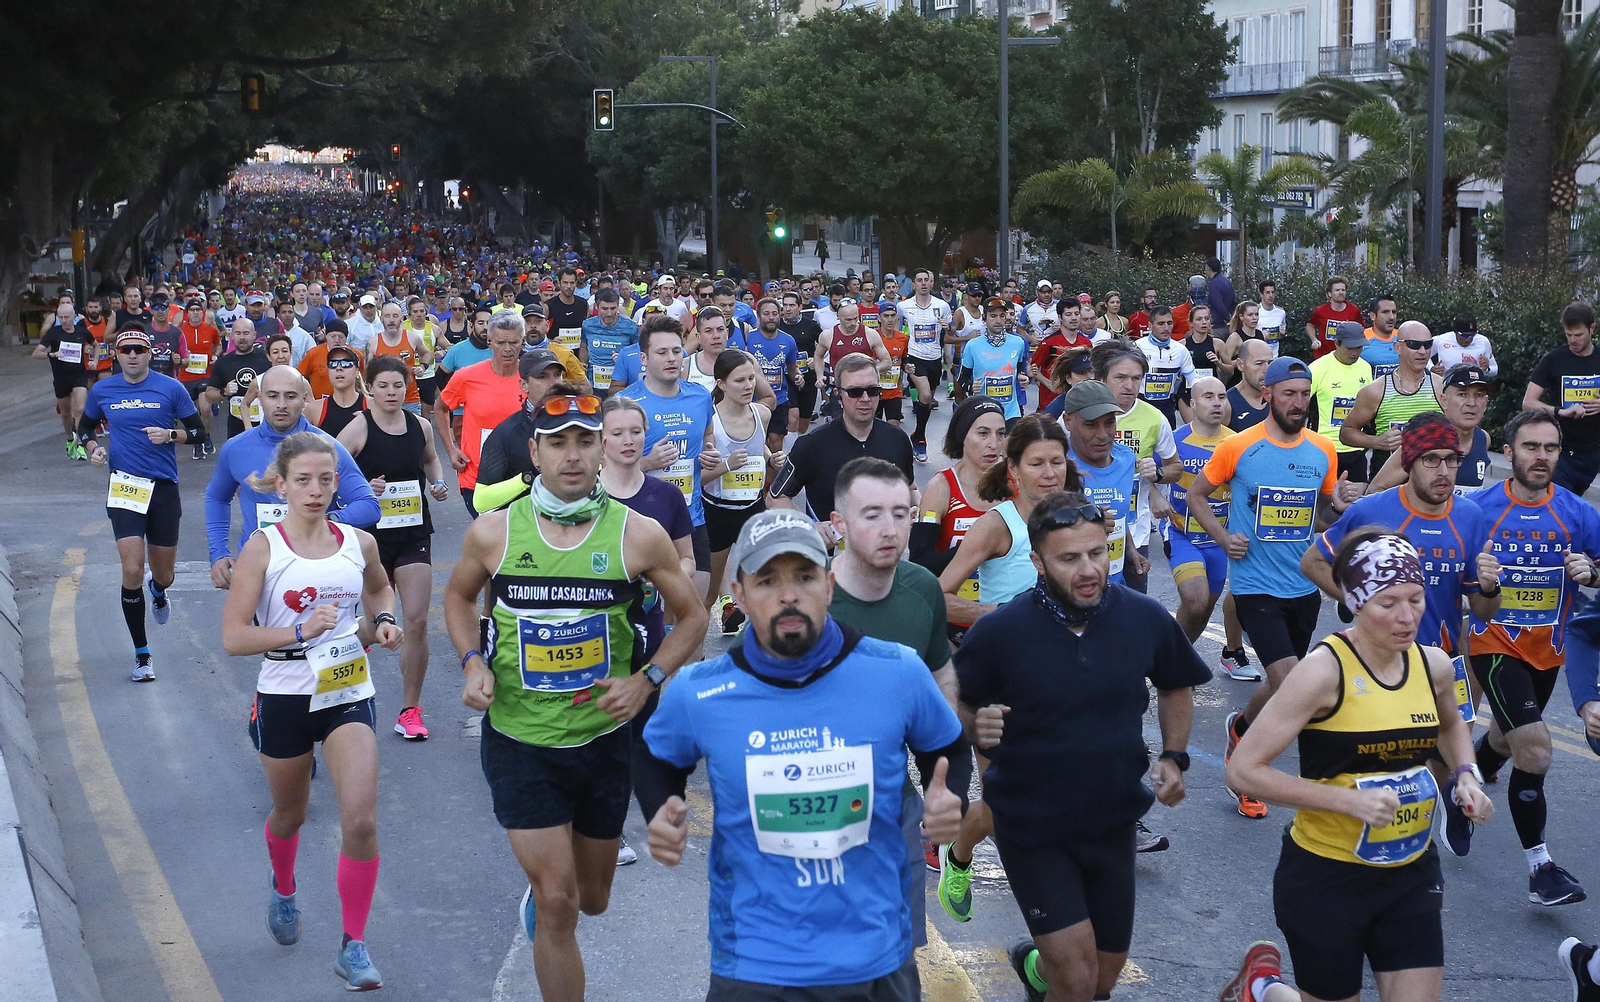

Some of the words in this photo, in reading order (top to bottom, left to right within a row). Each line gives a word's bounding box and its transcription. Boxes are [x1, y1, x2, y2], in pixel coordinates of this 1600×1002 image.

[120, 485, 138, 494] 5591
[391, 499, 411, 509] 5434
[1276, 509, 1299, 519] 1027
[1502, 530, 1557, 540] CLUB
[1417, 547, 1456, 559] LUB
[320, 586, 342, 596] Stiftung
[508, 585, 549, 600] STADIUM
[551, 586, 614, 601] CASABLANCA
[1515, 591, 1543, 601] 1238
[554, 625, 588, 637] ZURICH
[340, 642, 358, 653] ZURICH
[547, 646, 584, 662] 1453
[333, 663, 355, 681] 5557
[697, 684, 725, 699] luanvi
[1411, 713, 1438, 723] EMMA
[770, 728, 818, 742] ZURICH
[771, 739, 819, 753] MARATÓN
[1358, 741, 1397, 754] NIDD
[807, 761, 856, 776] ZURICH
[1395, 782, 1420, 796] ZURICH
[789, 795, 839, 815] 5327
[795, 858, 845, 887] SUN
